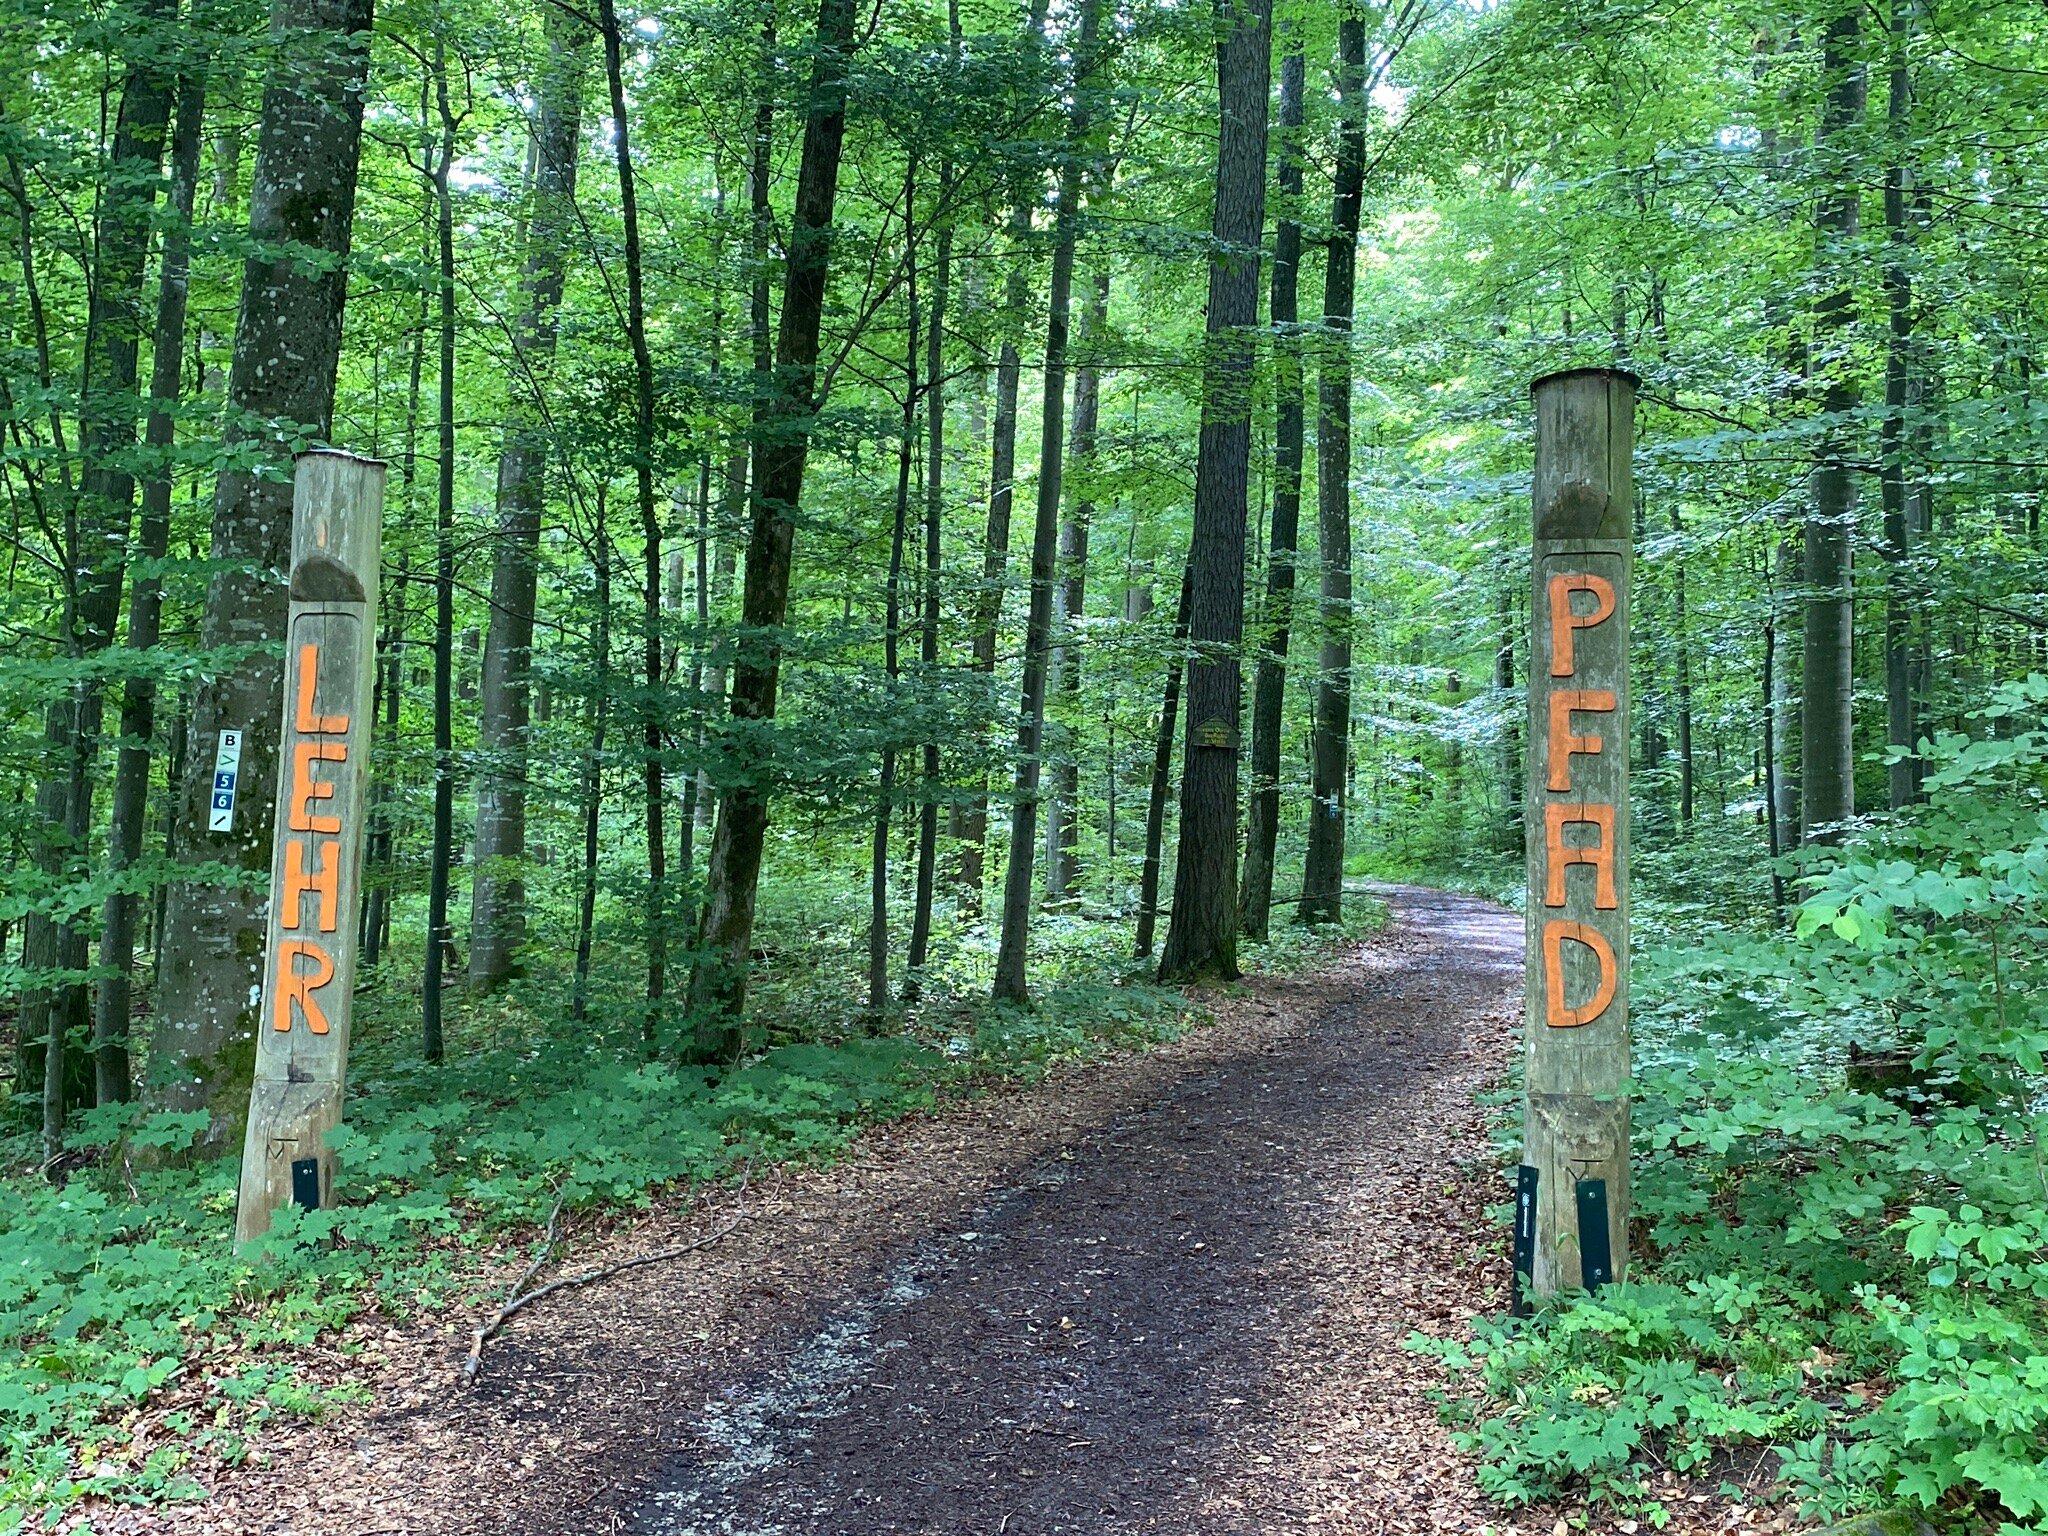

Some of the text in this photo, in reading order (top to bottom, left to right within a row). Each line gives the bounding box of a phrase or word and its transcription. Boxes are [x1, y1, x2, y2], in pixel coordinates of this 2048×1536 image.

[225, 735, 235, 746] B
[220, 775, 229, 787] 5
[218, 795, 227, 807] 6
[1543, 573, 1617, 1027] PFAD
[274, 643, 349, 1035] LEHR
